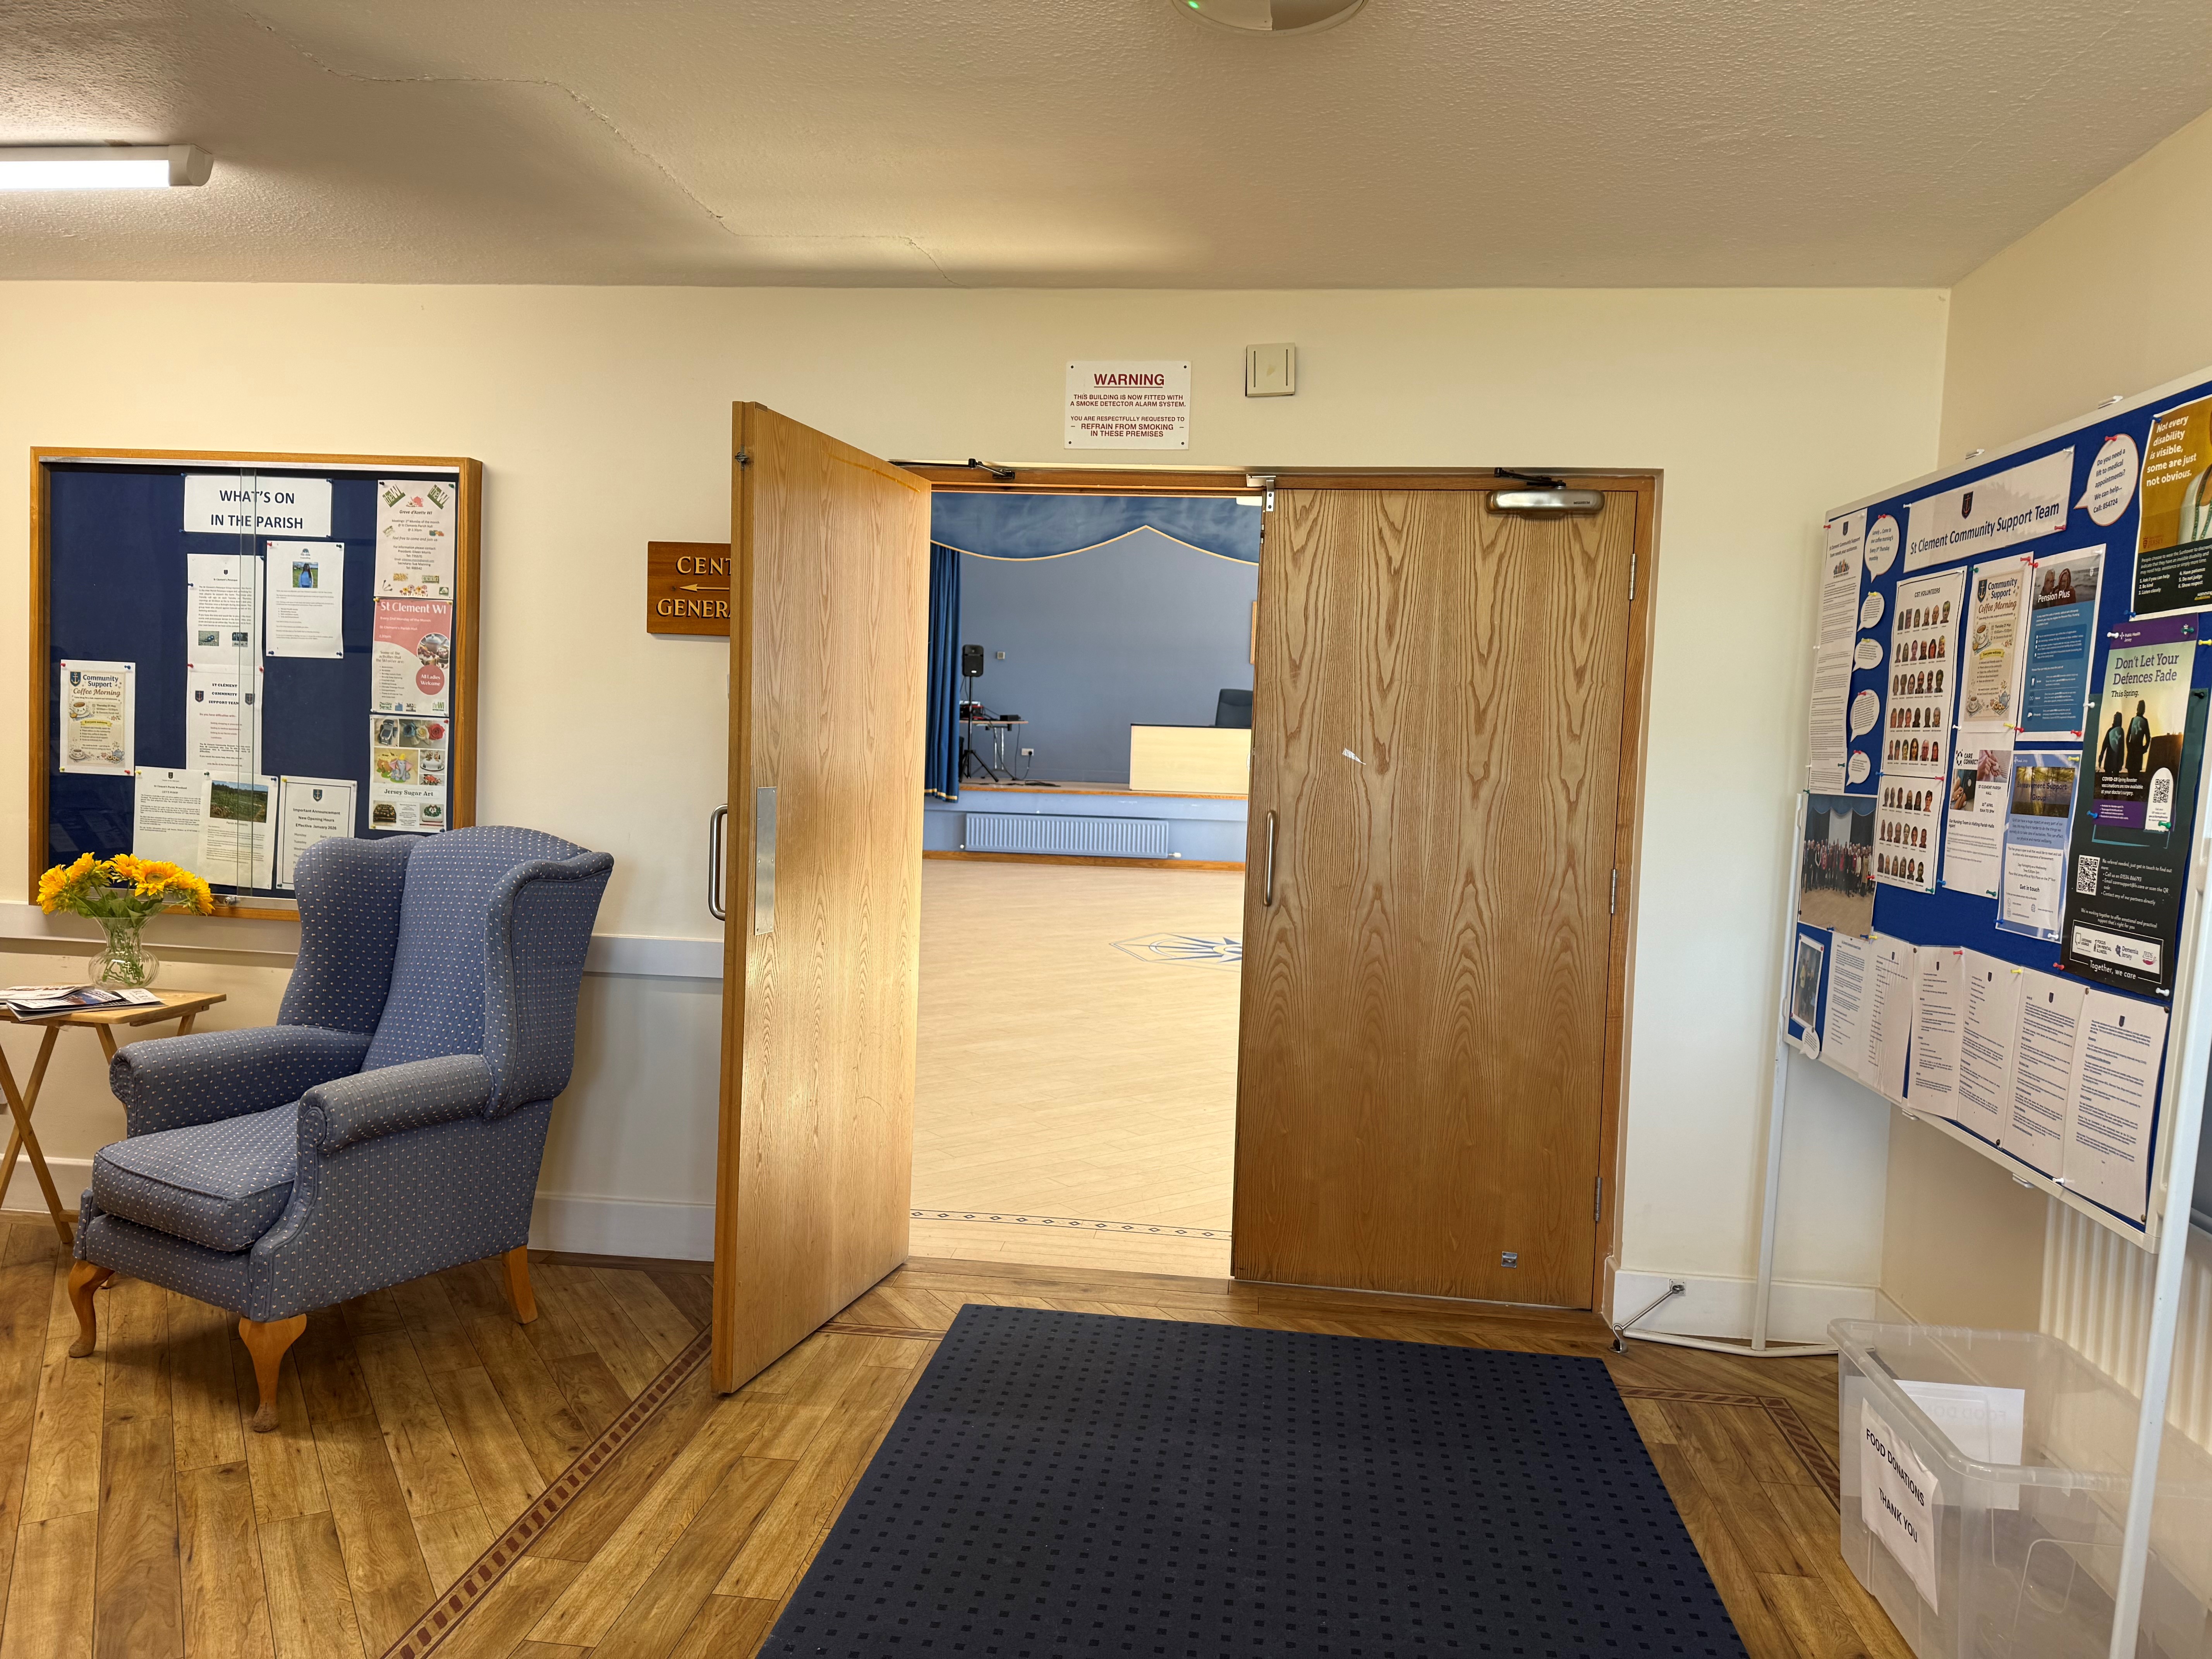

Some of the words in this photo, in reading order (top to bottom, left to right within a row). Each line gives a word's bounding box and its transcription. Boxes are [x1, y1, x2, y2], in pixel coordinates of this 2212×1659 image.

[1094, 374, 1164, 385] WARNING
[2157, 422, 2168, 433] Not
[2169, 416, 2189, 428] every
[2153, 431, 2185, 446] disability
[2112, 449, 2122, 459] need
[2157, 444, 2183, 458] visible,
[2108, 459, 2123, 471] medical
[2147, 463, 2167, 473] some
[2169, 459, 2181, 467] are
[2182, 453, 2197, 467] just
[2095, 469, 2125, 488] appointments?
[2147, 476, 2160, 486] not
[2161, 469, 2191, 482] obvious.
[220, 490, 271, 503] WHAT'S
[275, 493, 294, 503] ON
[211, 514, 223, 525] IN
[228, 515, 251, 526] THE
[257, 516, 303, 529] PARISH
[1911, 542, 1917, 555] St
[1918, 533, 1948, 552] Clement
[1950, 521, 1995, 544] Community
[1997, 509, 2032, 531] Support
[2035, 503, 2059, 519] Team
[1988, 578, 2017, 590] Community
[1991, 589, 2011, 600] Support
[2038, 592, 2057, 603] Pension
[2059, 591, 2070, 599] Plus
[381, 602, 390, 611] St
[392, 603, 429, 613] Clement
[433, 605, 446, 614] WI
[658, 599, 730, 618] GENER
[1978, 603, 1993, 614] Coffee
[1994, 600, 2016, 612] Morning
[2115, 655, 2138, 669] Don't
[2140, 655, 2155, 667] Let
[2157, 653, 2179, 666] Your
[2113, 672, 2153, 685] Defences
[2154, 669, 2177, 682] Fade
[94, 689, 120, 697] Morning
[2124, 690, 2139, 698] Spring.
[2047, 783, 2067, 792] Support
[2122, 946, 2138, 955] Dementia
[2090, 960, 2113, 974] Together,
[1866, 1428, 1885, 1457] FOOD
[1887, 1450, 1924, 1506] DONATIONS
[1879, 1487, 1901, 1525] THANK
[1904, 1516, 1917, 1543] YOU
